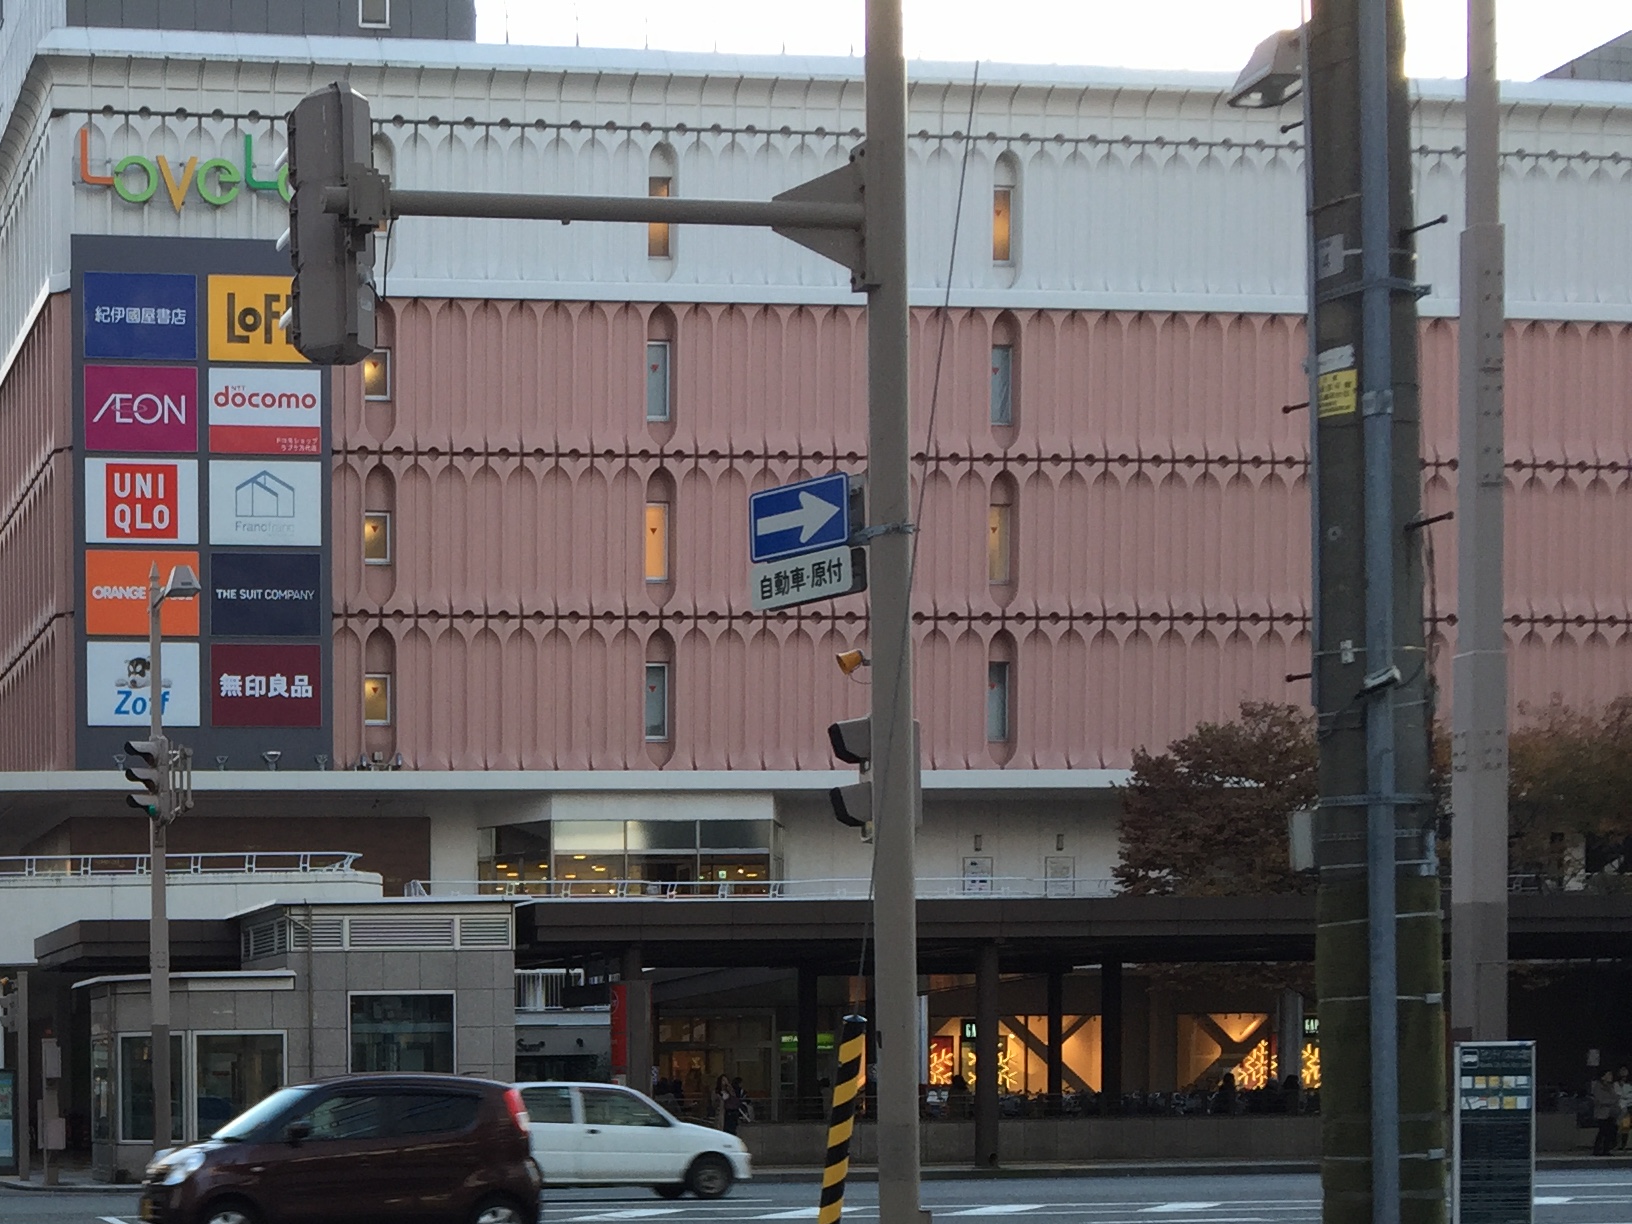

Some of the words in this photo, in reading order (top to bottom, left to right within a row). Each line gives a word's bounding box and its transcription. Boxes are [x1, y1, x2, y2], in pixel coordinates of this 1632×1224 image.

[80, 128, 289, 213] LoveL
[94, 305, 187, 325] 紀伊國屋書店
[213, 385, 317, 409] docomo
[113, 472, 165, 499] UNI
[113, 503, 171, 534] QLO
[91, 585, 147, 601] ORANGE
[215, 588, 237, 600] THE
[239, 588, 263, 600] SUIT
[264, 588, 316, 601] COMPANY
[218, 672, 313, 698] 無印良品
[114, 690, 171, 715] Zof
